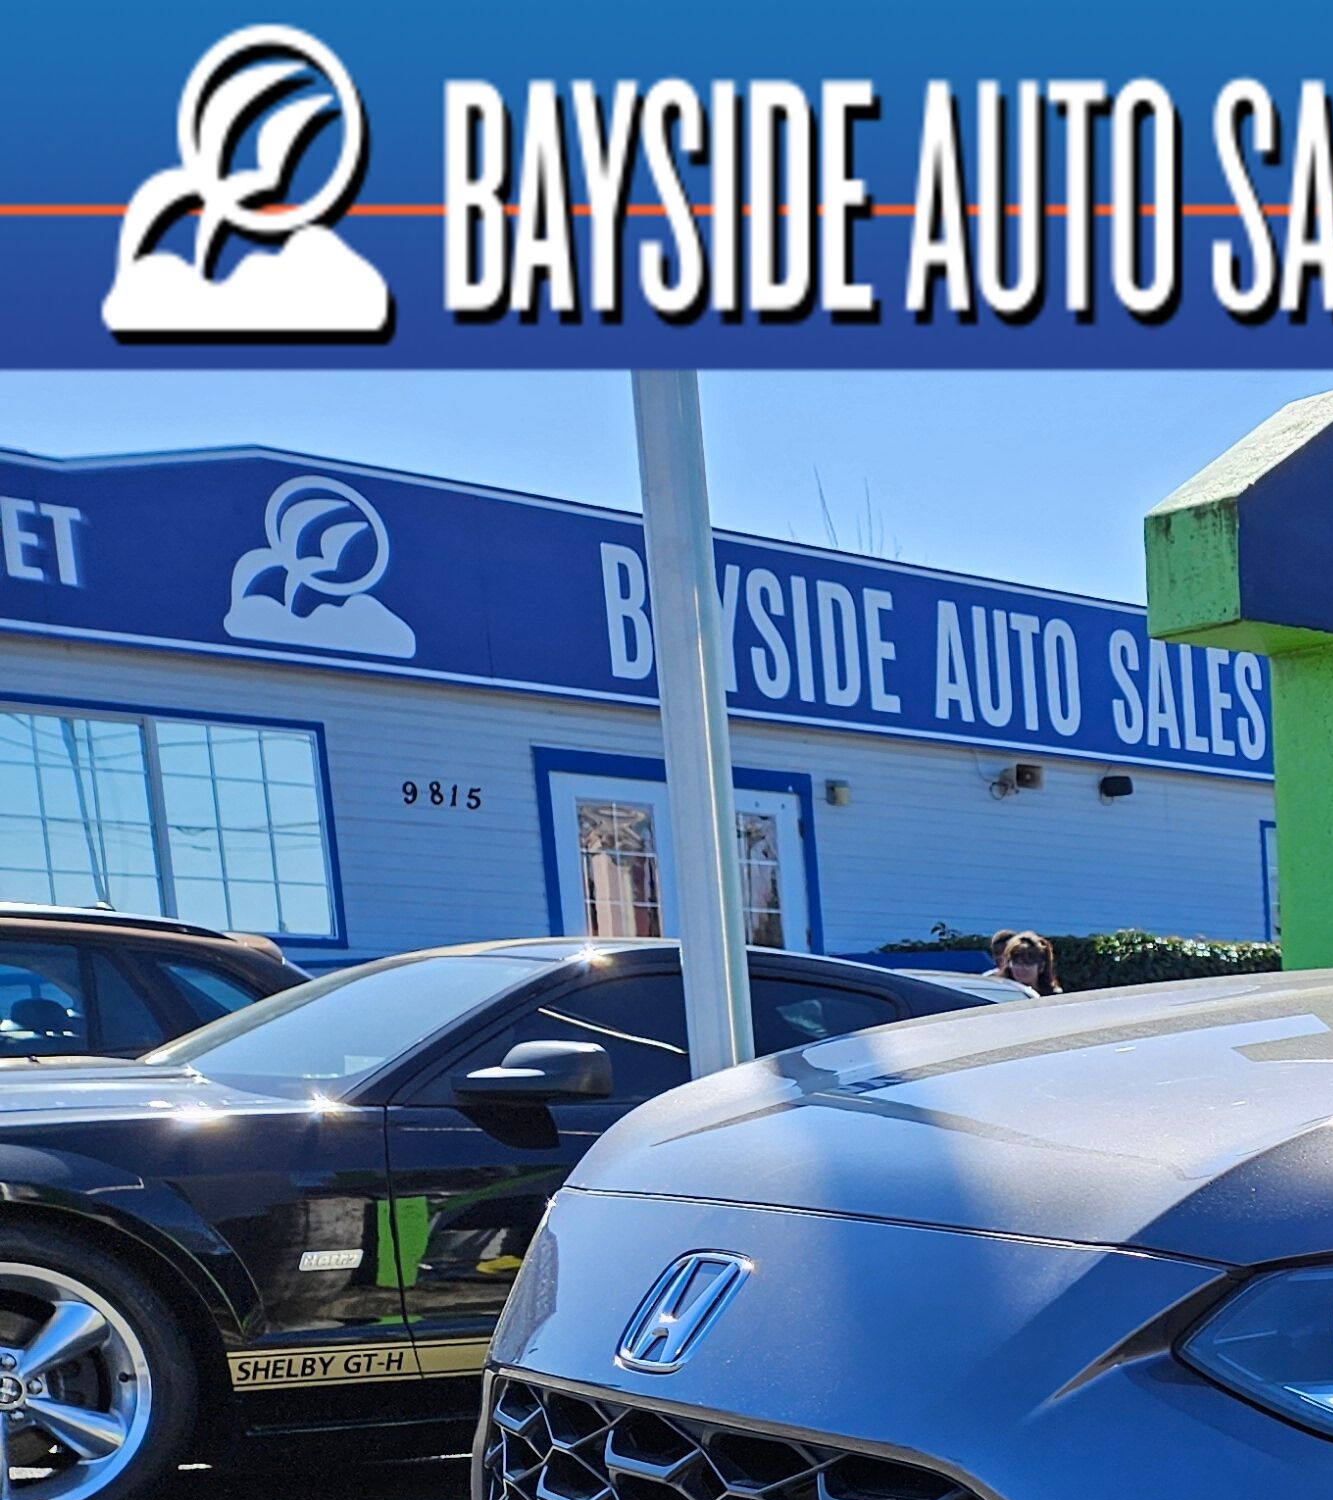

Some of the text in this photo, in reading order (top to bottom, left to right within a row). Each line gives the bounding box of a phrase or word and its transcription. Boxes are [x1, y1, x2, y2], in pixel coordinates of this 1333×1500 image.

[0, 496, 82, 586] ET
[600, 542, 1266, 761] BYSIDE AUTO SALES
[402, 781, 481, 810] 9815
[236, 1352, 404, 1382] SHELBY GT-H
